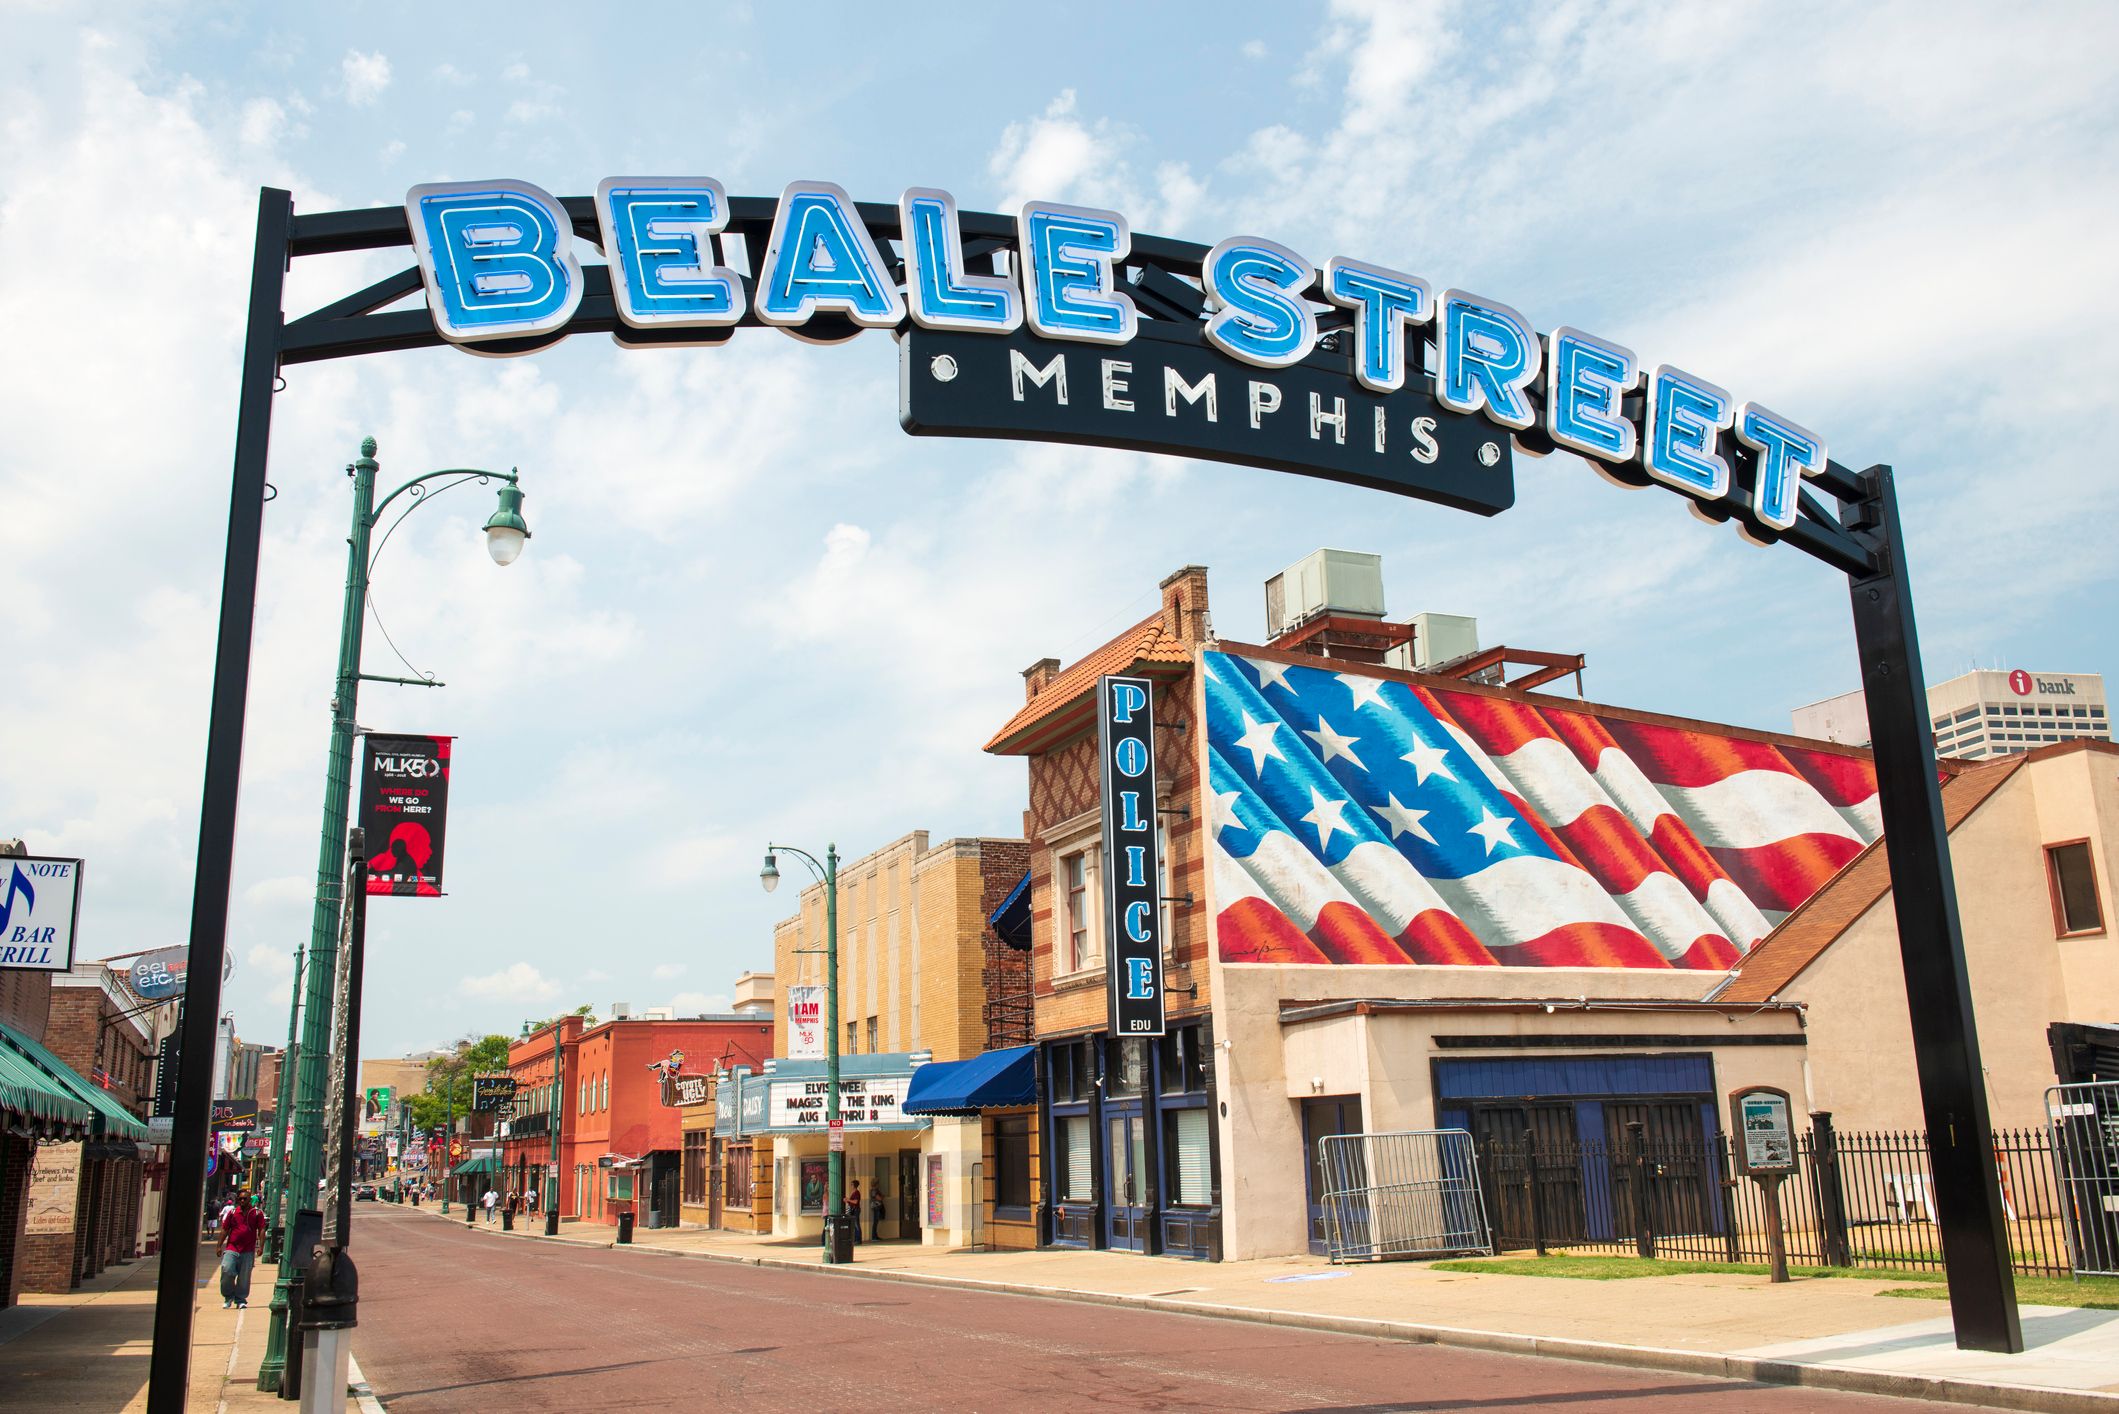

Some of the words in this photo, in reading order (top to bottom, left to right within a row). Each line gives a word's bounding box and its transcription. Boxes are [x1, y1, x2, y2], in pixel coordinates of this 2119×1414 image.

[406, 177, 1138, 345] BEALE
[1202, 235, 1828, 530] STREET
[1009, 349, 1439, 465] MEMPHIS
[2037, 677, 2076, 695] bank
[379, 788, 413, 796] WHERE
[414, 788, 429, 796] DO
[389, 796, 404, 804] WE
[405, 796, 419, 804] GO
[375, 805, 402, 813] FROM
[403, 805, 432, 814] HERE?
[1112, 683, 1154, 1000] POLICE
[26, 863, 71, 878] NOTE
[10, 926, 56, 943] BAR
[0, 946, 52, 963] RILL
[795, 1003, 799, 1015] I
[801, 1003, 819, 1015] AM
[1130, 1019, 1151, 1031] EDU
[675, 1078, 704, 1091] COYOTE
[839, 1081, 867, 1094] WEEK
[682, 1086, 707, 1100] UGLY
[743, 1095, 763, 1116] DAISY
[786, 1097, 823, 1109] IMAGES
[846, 1096, 865, 1107] THE
[871, 1094, 895, 1106] KING
[798, 1111, 819, 1123] AUG
[838, 1109, 865, 1121] THRU
